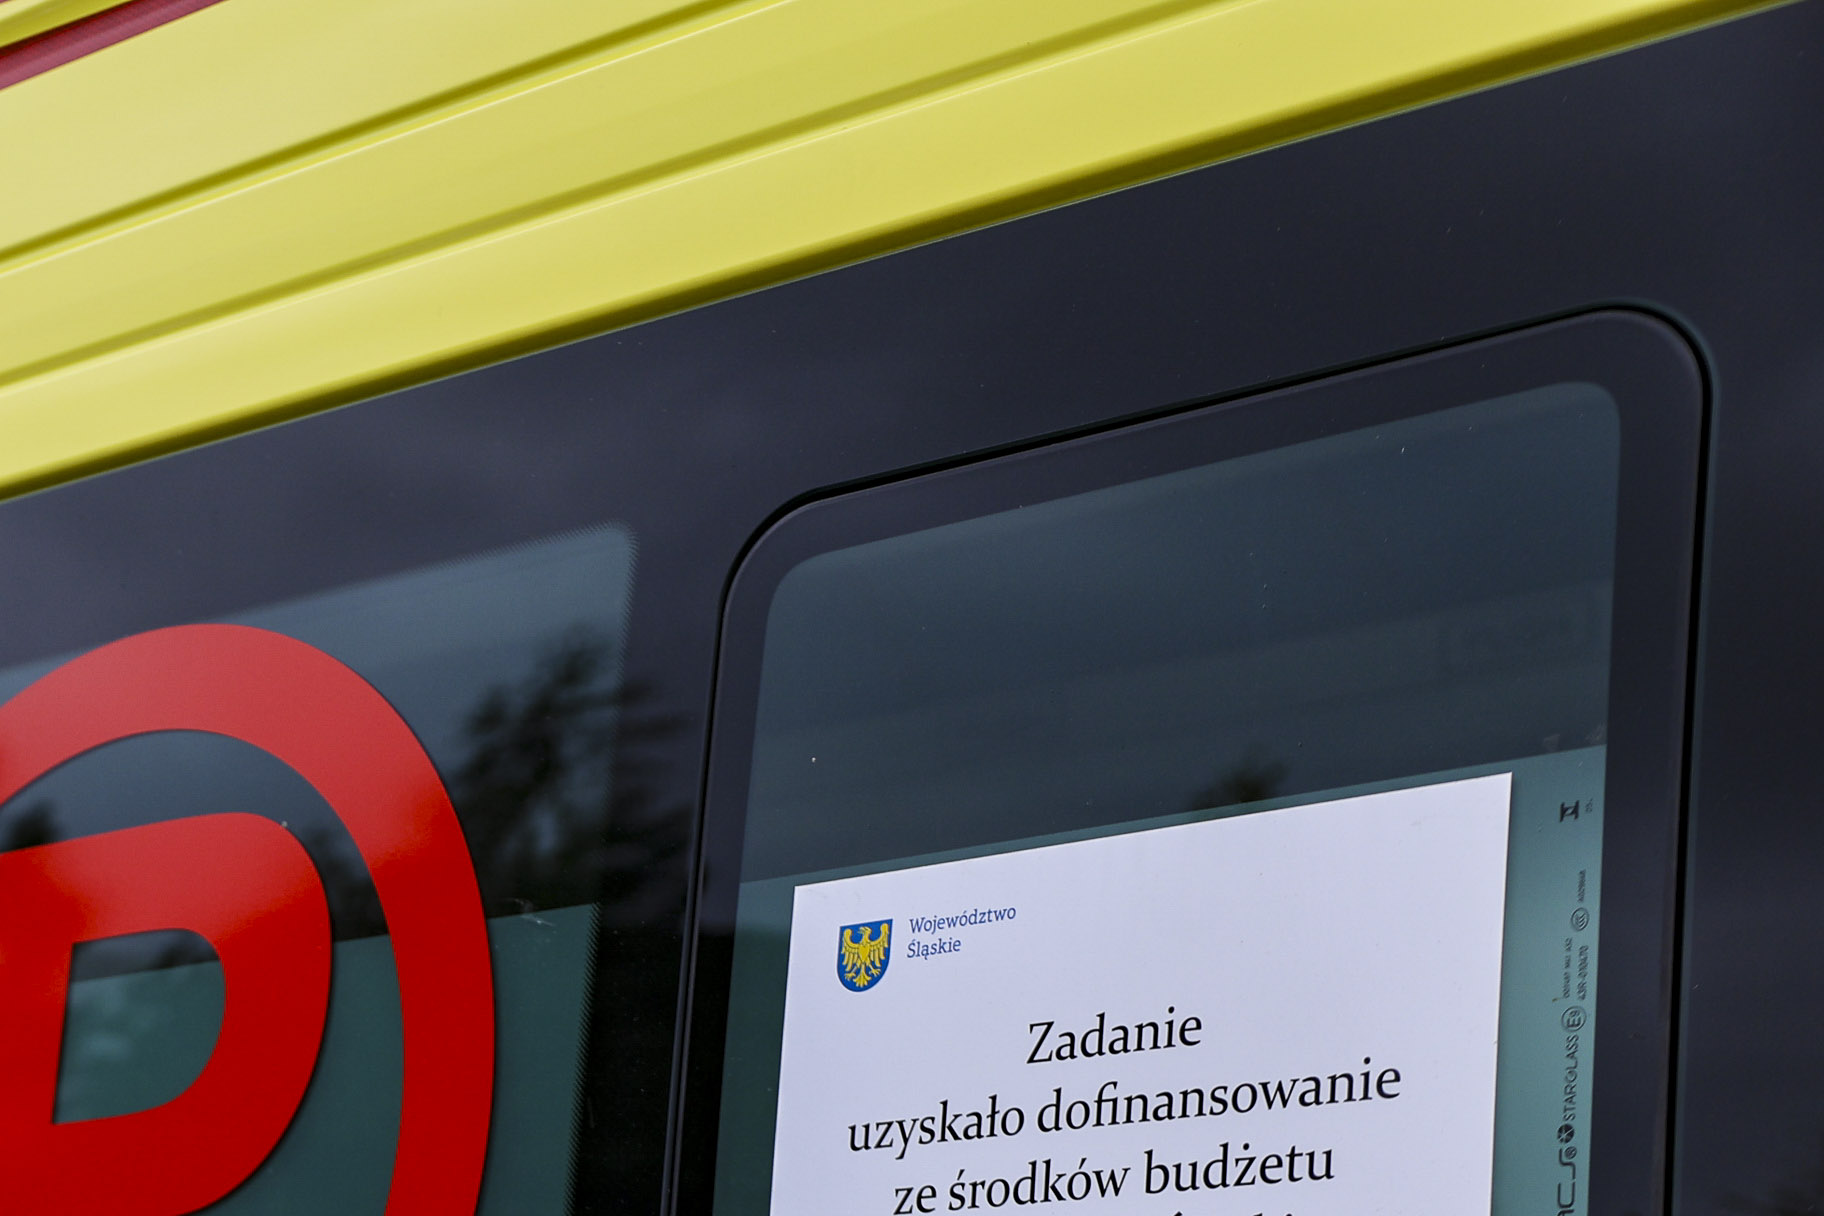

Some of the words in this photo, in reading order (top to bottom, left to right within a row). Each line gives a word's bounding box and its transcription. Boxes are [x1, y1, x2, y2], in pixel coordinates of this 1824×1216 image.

[907, 939, 962, 960] Śląskie
[909, 907, 1017, 935] Województwo
[1026, 1006, 1203, 1065] Zadanie
[848, 1095, 1025, 1160] uzyskało
[1037, 1056, 1402, 1136] dofinansowanie
[893, 1179, 937, 1216] ze
[948, 1156, 1131, 1212] środków
[1143, 1140, 1334, 1197] budżetu
